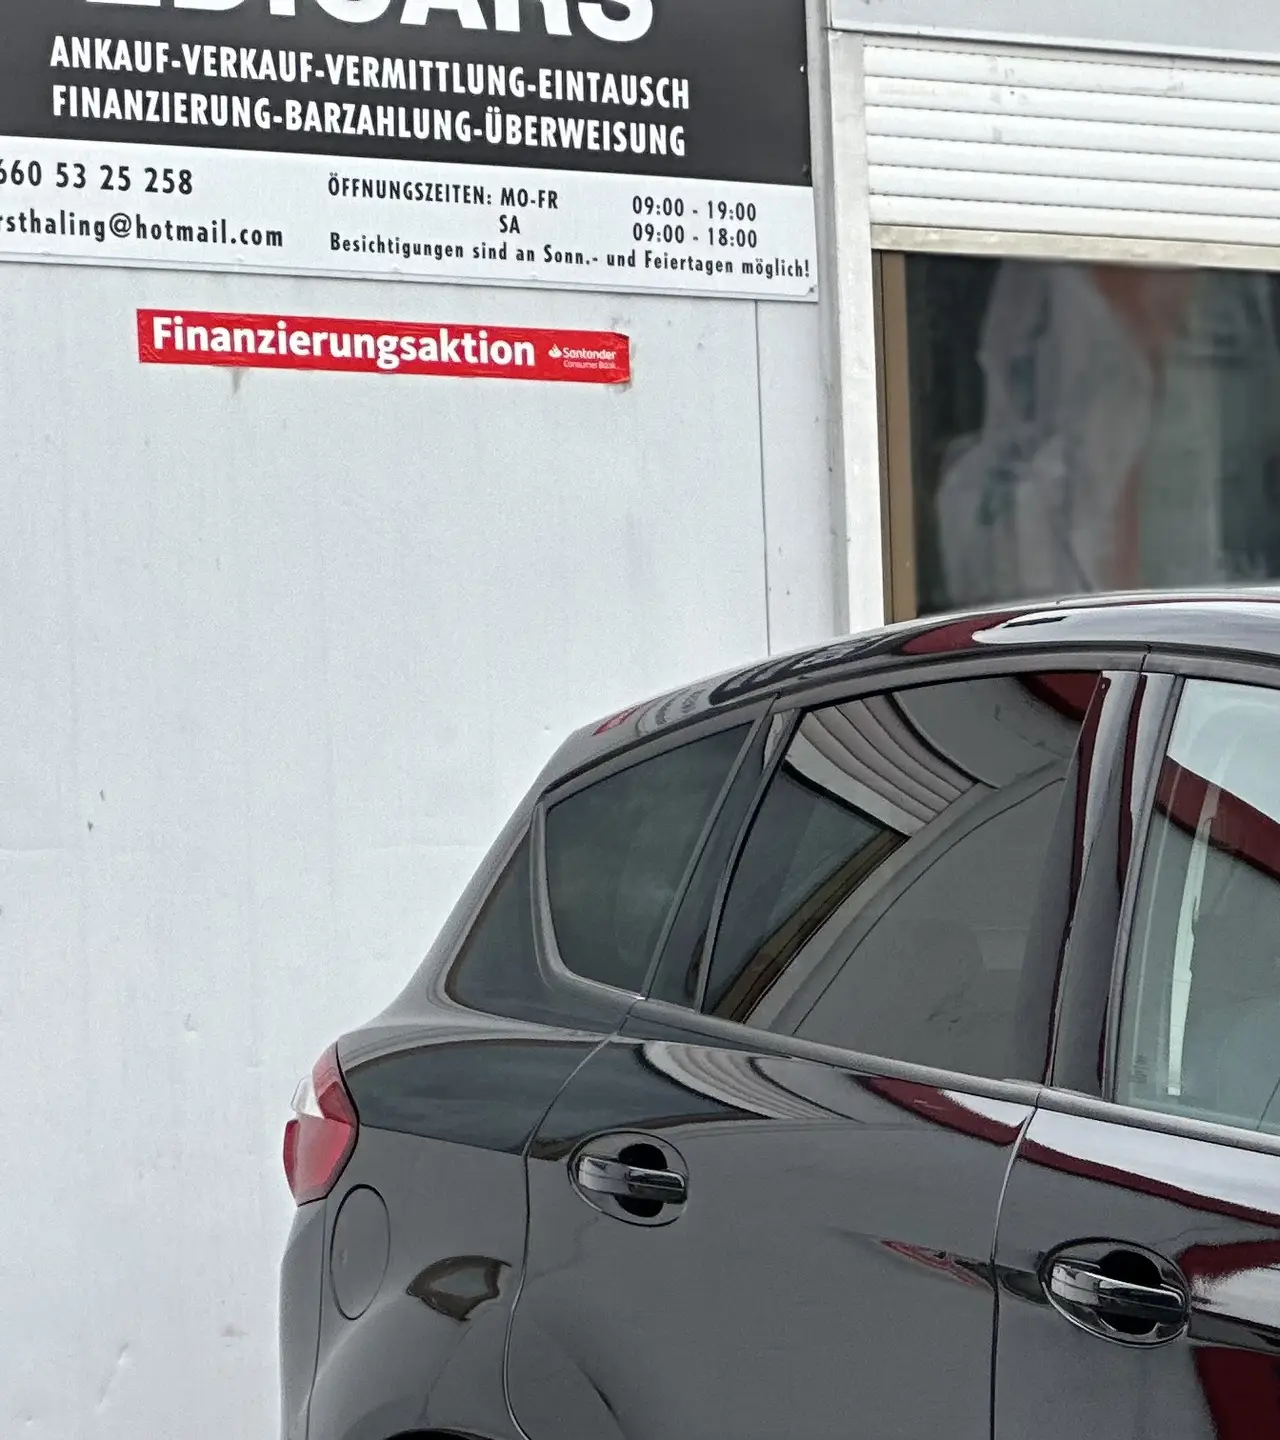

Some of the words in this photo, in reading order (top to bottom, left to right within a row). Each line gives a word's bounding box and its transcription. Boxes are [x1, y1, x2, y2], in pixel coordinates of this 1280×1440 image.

[50, 36, 689, 109] ANKAUF-VERKAUF-VERMITTLUNG-EINTAUSCH
[52, 85, 685, 157] FINANZIERUNG-BARZAHLUNG-ÜBERWEISUNG
[56, 162, 87, 188] 53
[100, 165, 131, 191] 25
[145, 167, 193, 195] 258
[328, 172, 492, 205] ÖFFNUNGSZEITEN:
[501, 187, 558, 209] MO-FR
[632, 195, 685, 217] 09:00
[707, 200, 757, 222] 19:00
[330, 231, 464, 261] Besichtigungen
[472, 241, 508, 261] sind
[515, 248, 535, 262] an
[606, 249, 636, 269] und
[644, 249, 734, 276] Feiertagen
[741, 258, 810, 280] möglich!
[499, 214, 521, 234] SA
[632, 222, 685, 244] 09:00
[708, 227, 758, 248] 18:00
[152, 315, 536, 370] Finanzierungsaktion
[563, 347, 616, 360] Santander
